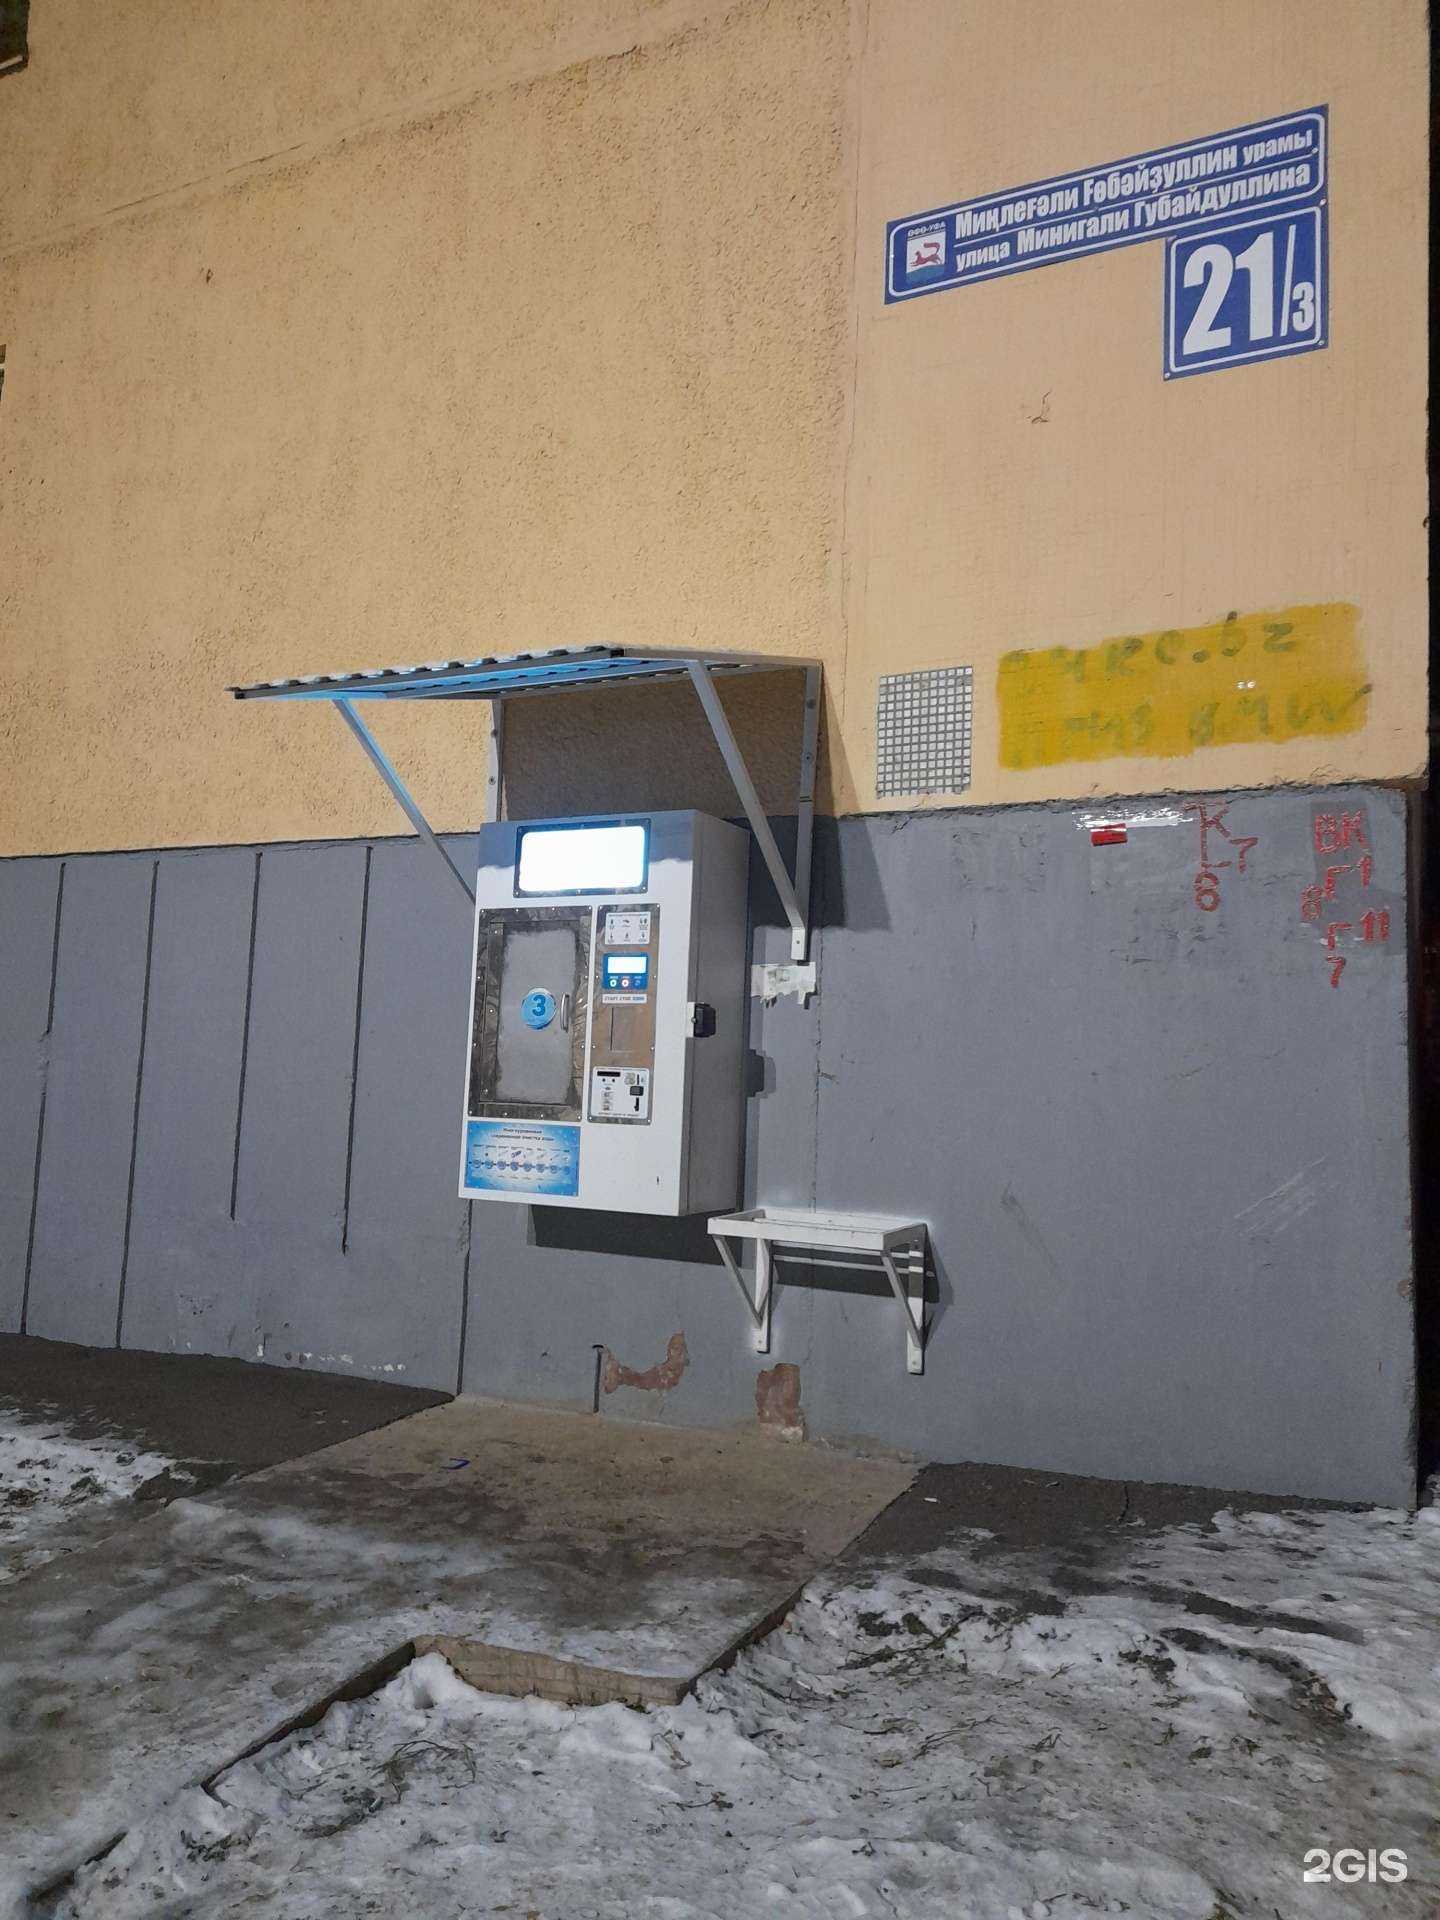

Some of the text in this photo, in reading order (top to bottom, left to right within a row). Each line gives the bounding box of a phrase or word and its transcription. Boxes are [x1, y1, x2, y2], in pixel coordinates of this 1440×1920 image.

[955, 187, 1079, 240] Миңлеғәли
[1242, 129, 1313, 166] урамы
[956, 163, 1311, 272] улица Минигали Губайдуллина
[532, 994, 546, 1017] 3
